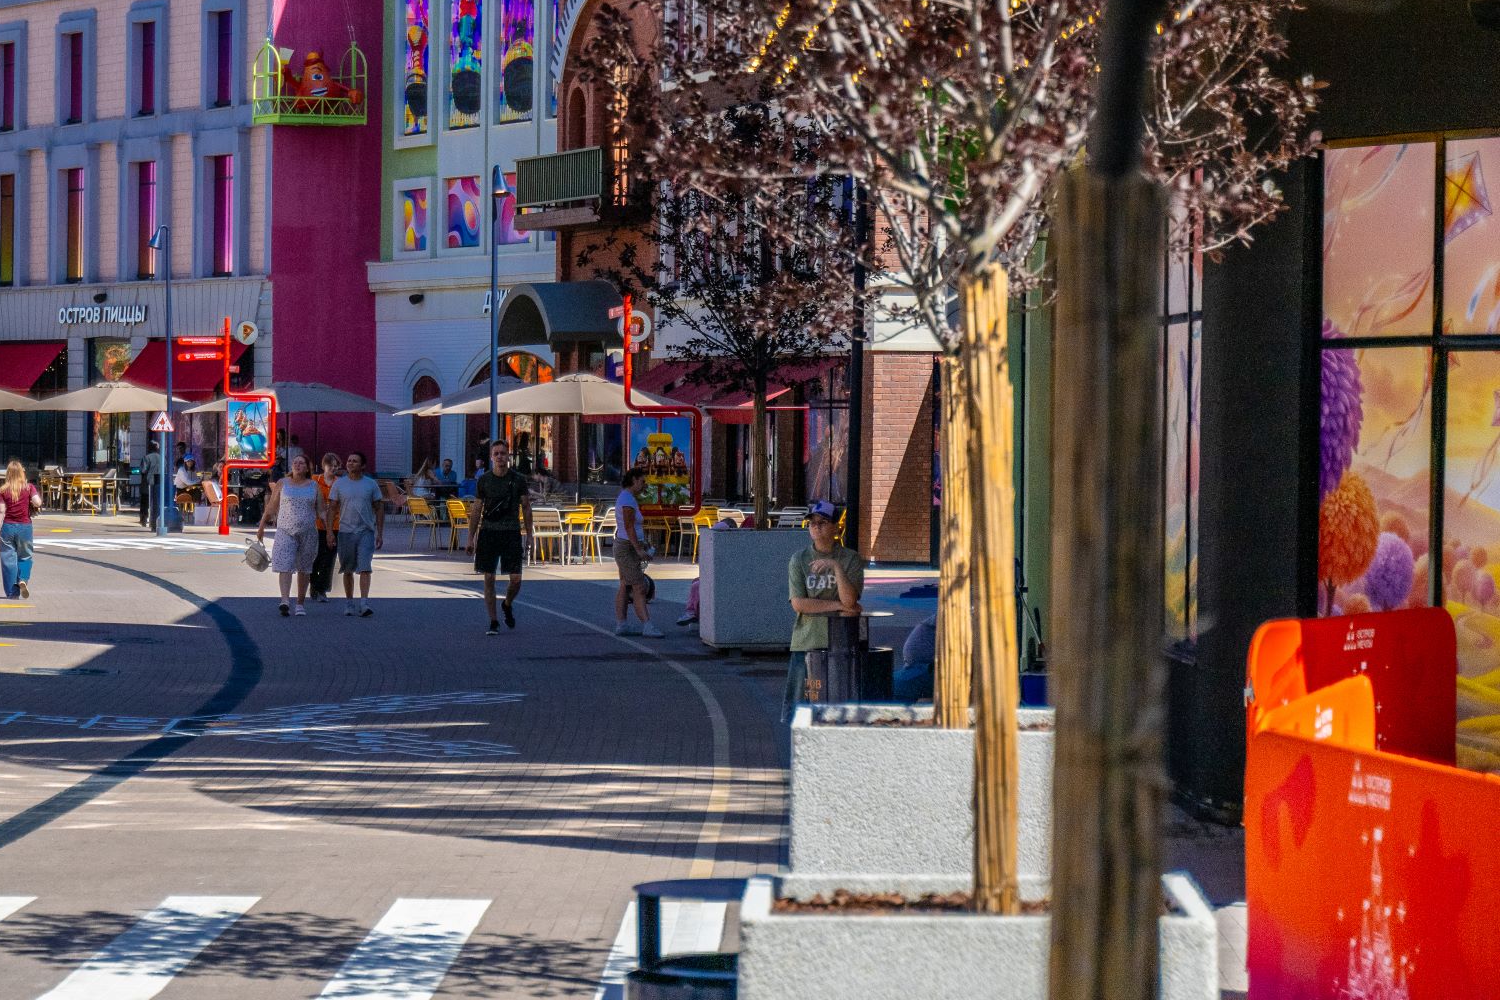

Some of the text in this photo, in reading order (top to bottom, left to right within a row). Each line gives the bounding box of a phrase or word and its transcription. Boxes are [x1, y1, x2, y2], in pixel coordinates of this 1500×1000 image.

[58, 304, 146, 326] ОСТРОВ ПИЦЦЫ
[806, 575, 837, 589] GAP
